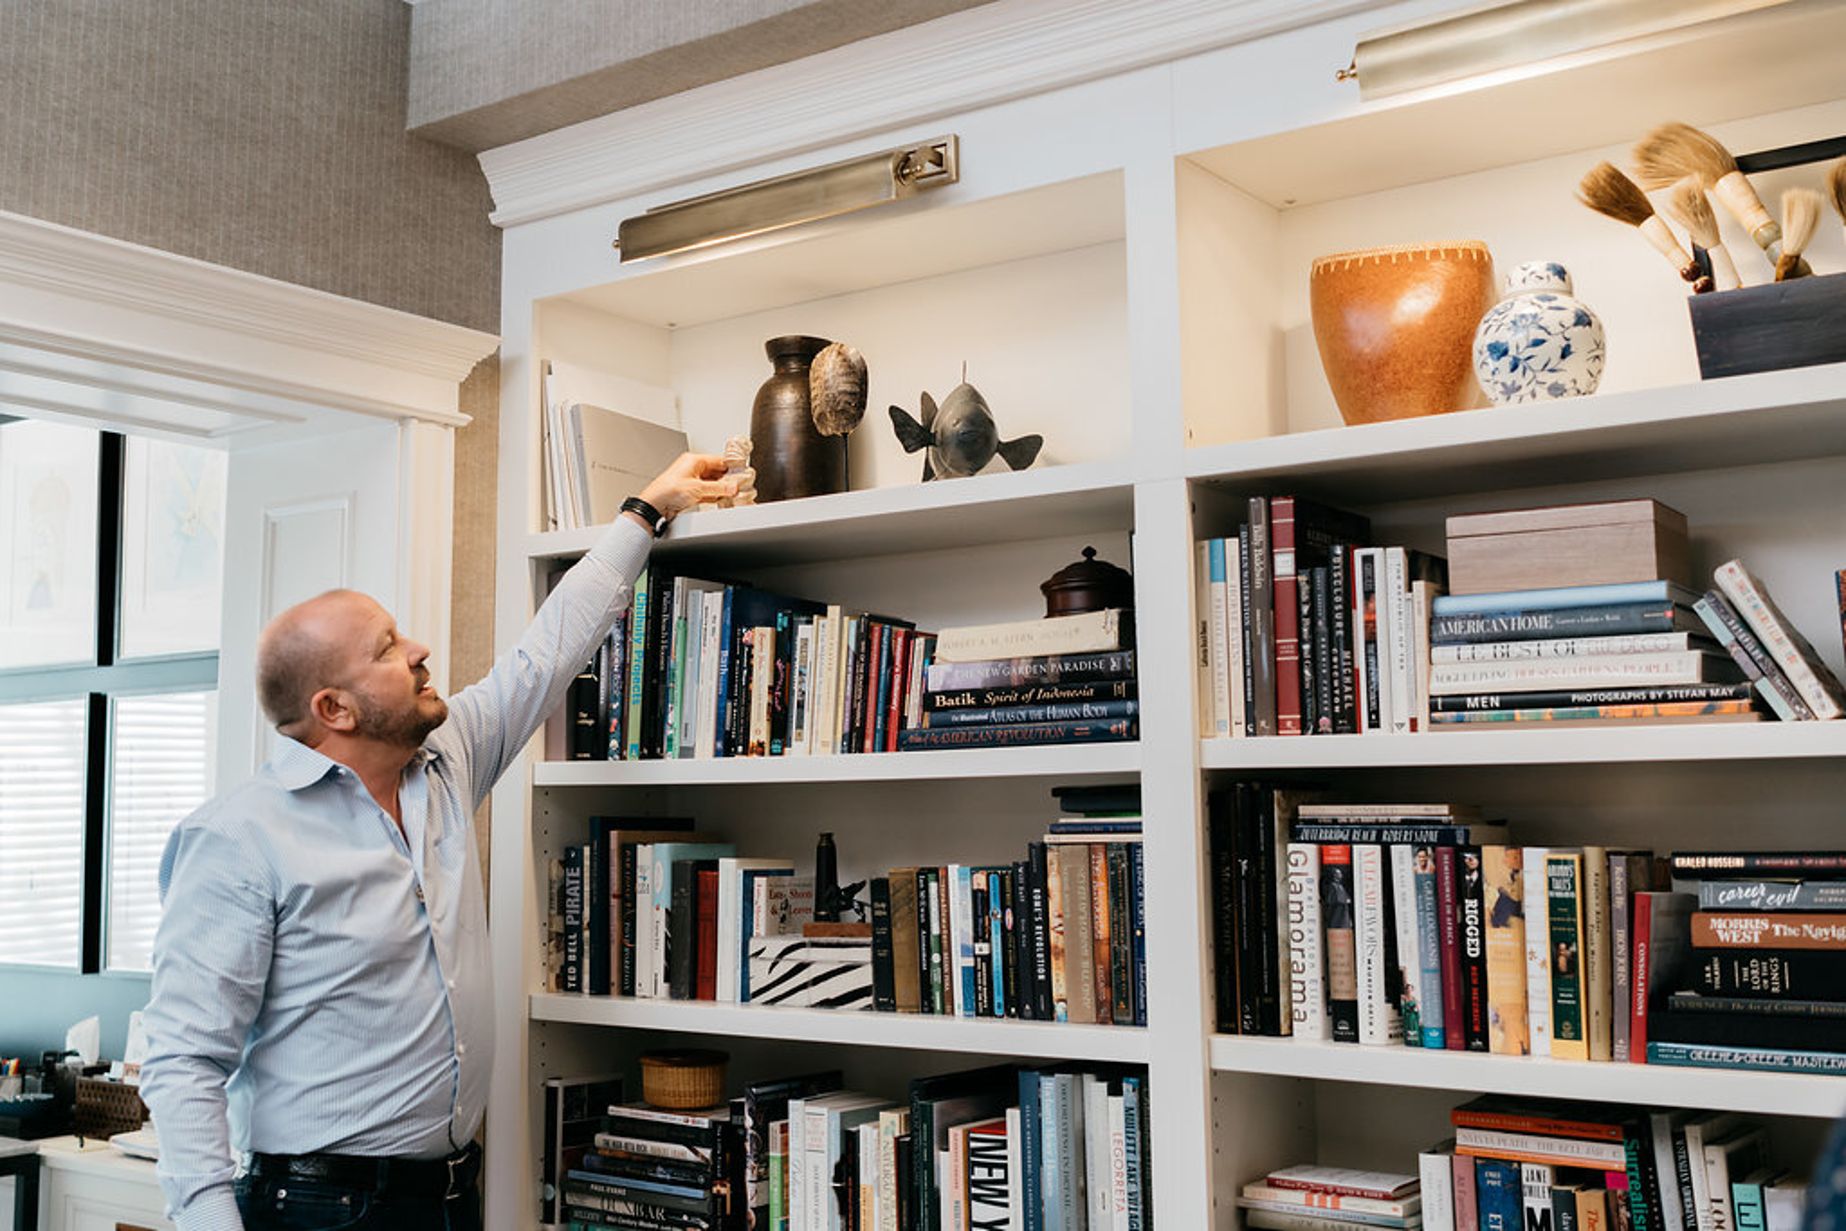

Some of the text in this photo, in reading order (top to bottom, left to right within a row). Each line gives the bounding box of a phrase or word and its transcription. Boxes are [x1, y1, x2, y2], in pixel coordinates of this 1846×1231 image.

[1253, 548, 1266, 590] Baldwin
[1332, 556, 1344, 637] DISCLOSURE
[1438, 616, 1508, 637] AMERICAN
[1510, 613, 1554, 633] HOME
[631, 592, 648, 706] Chihuly Projects
[1001, 665, 1047, 678] GARDEN
[1050, 662, 1105, 675] PARADISE
[1331, 647, 1341, 714] CRICHTON
[1343, 648, 1354, 710] MICHAEL
[934, 684, 1096, 708] Batik Spirit of Indonesia
[1046, 703, 1081, 718] HUMAN
[1082, 702, 1109, 716] BODY
[1466, 686, 1736, 710] MEN PHOTOGRAPHS BY STEFAN MAY
[1613, 866, 1625, 895] Robert
[1717, 882, 1765, 905] career
[1764, 883, 1802, 909] evil
[565, 866, 581, 989] TED BELL PIRATE
[1033, 888, 1046, 980] ROME'S REVOLUTION
[1289, 849, 1308, 1024] Glamorama
[1465, 899, 1482, 958] RIGGED
[1615, 928, 1626, 955] IRON
[1709, 917, 1771, 932] MORRIS
[1715, 930, 1765, 945] WEST
[1770, 922, 1800, 939] The
[1306, 877, 1320, 1015] Bret Easton Ellis
[1616, 956, 1627, 987] JOHN
[1635, 942, 1647, 1017] CONSOLATIONS
[1749, 958, 1761, 991] LORD
[1760, 961, 1769, 990] OF THE
[1768, 956, 1780, 994] RINGS
[1472, 987, 1482, 1032] MEZRICH
[1060, 1082, 1072, 1209] DECORATING IN DETAIL
[1123, 1105, 1137, 1156] MULLETT
[970, 1136, 1009, 1207] NEW
[1112, 1131, 1126, 1214] LEGORRETA
[1126, 1159, 1138, 1185] LAKE
[1525, 1168, 1548, 1184] JANE
[602, 1196, 667, 1221] DUNBAR
